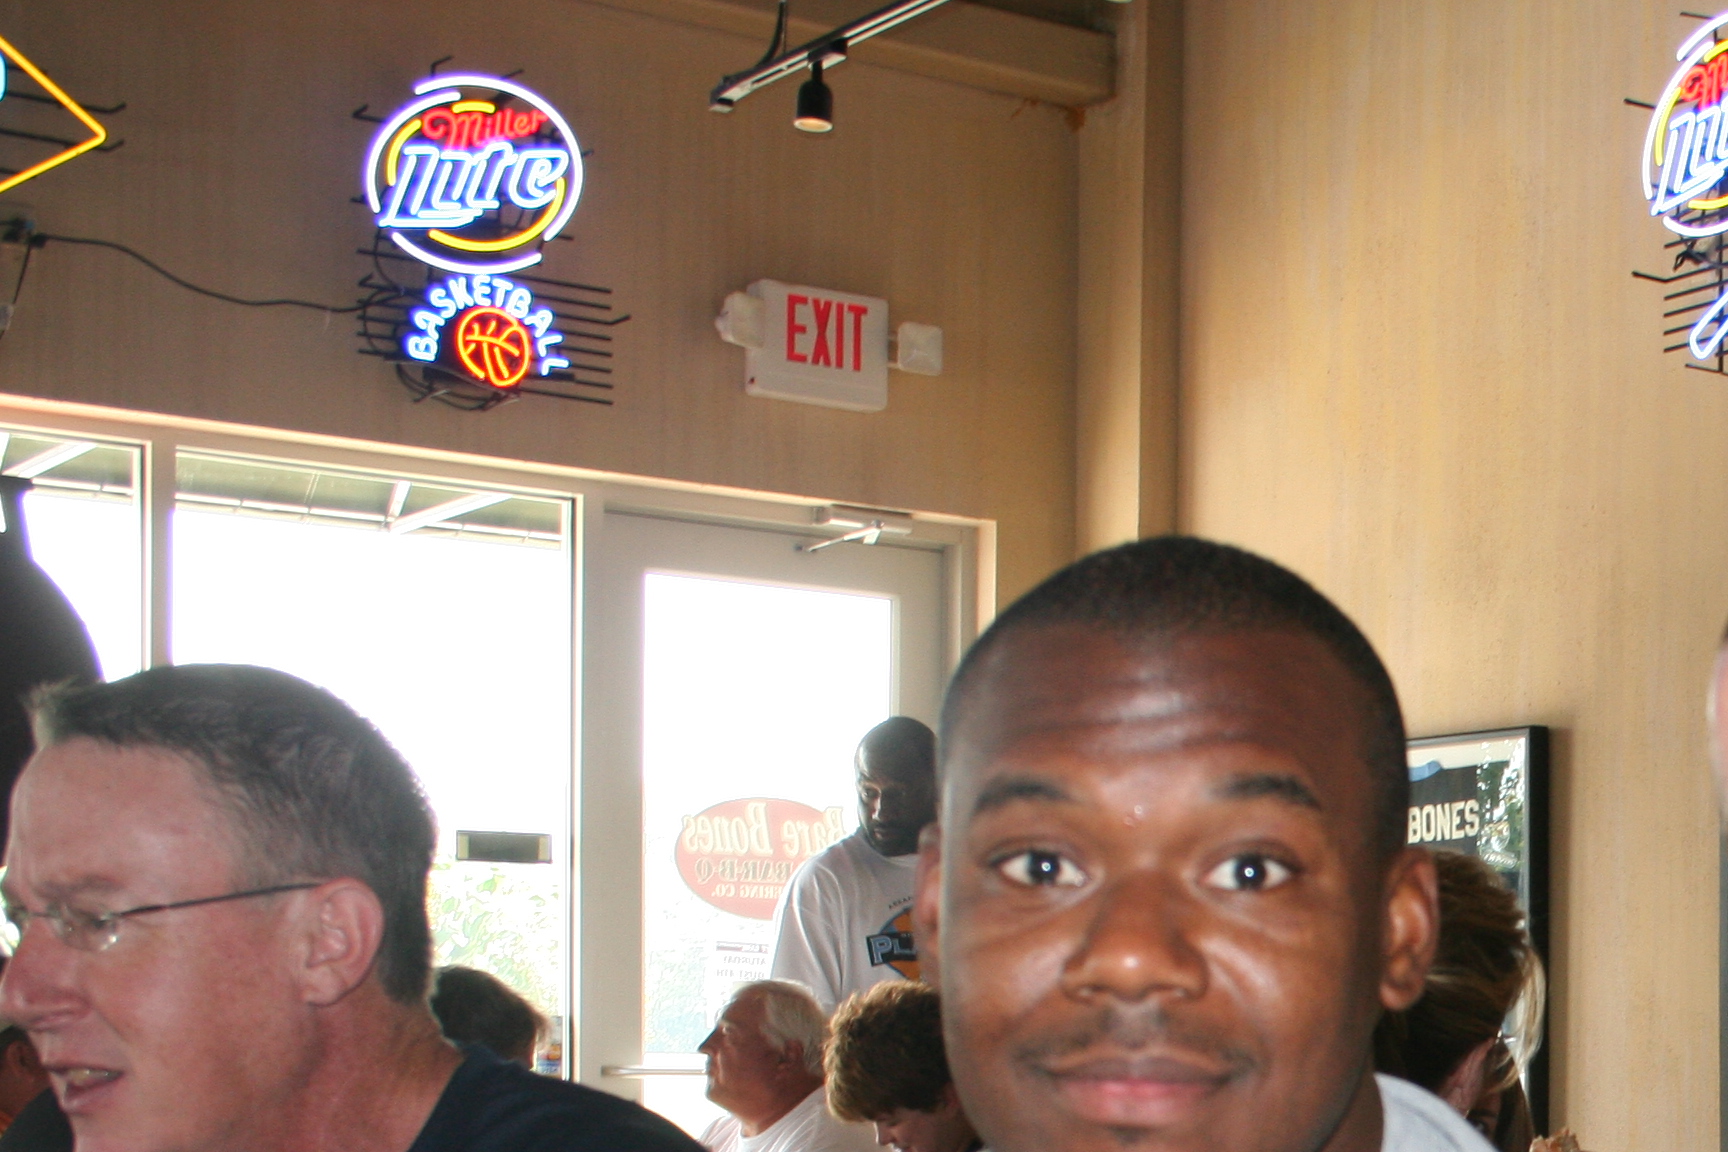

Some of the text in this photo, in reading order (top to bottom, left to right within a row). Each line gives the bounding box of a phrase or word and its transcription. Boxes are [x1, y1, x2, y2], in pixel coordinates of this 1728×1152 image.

[421, 107, 548, 150] Miller
[378, 141, 570, 228] Lite
[408, 274, 571, 376] BASKETBALL
[785, 292, 869, 373] EXIT
[1407, 798, 1480, 844] BONES
